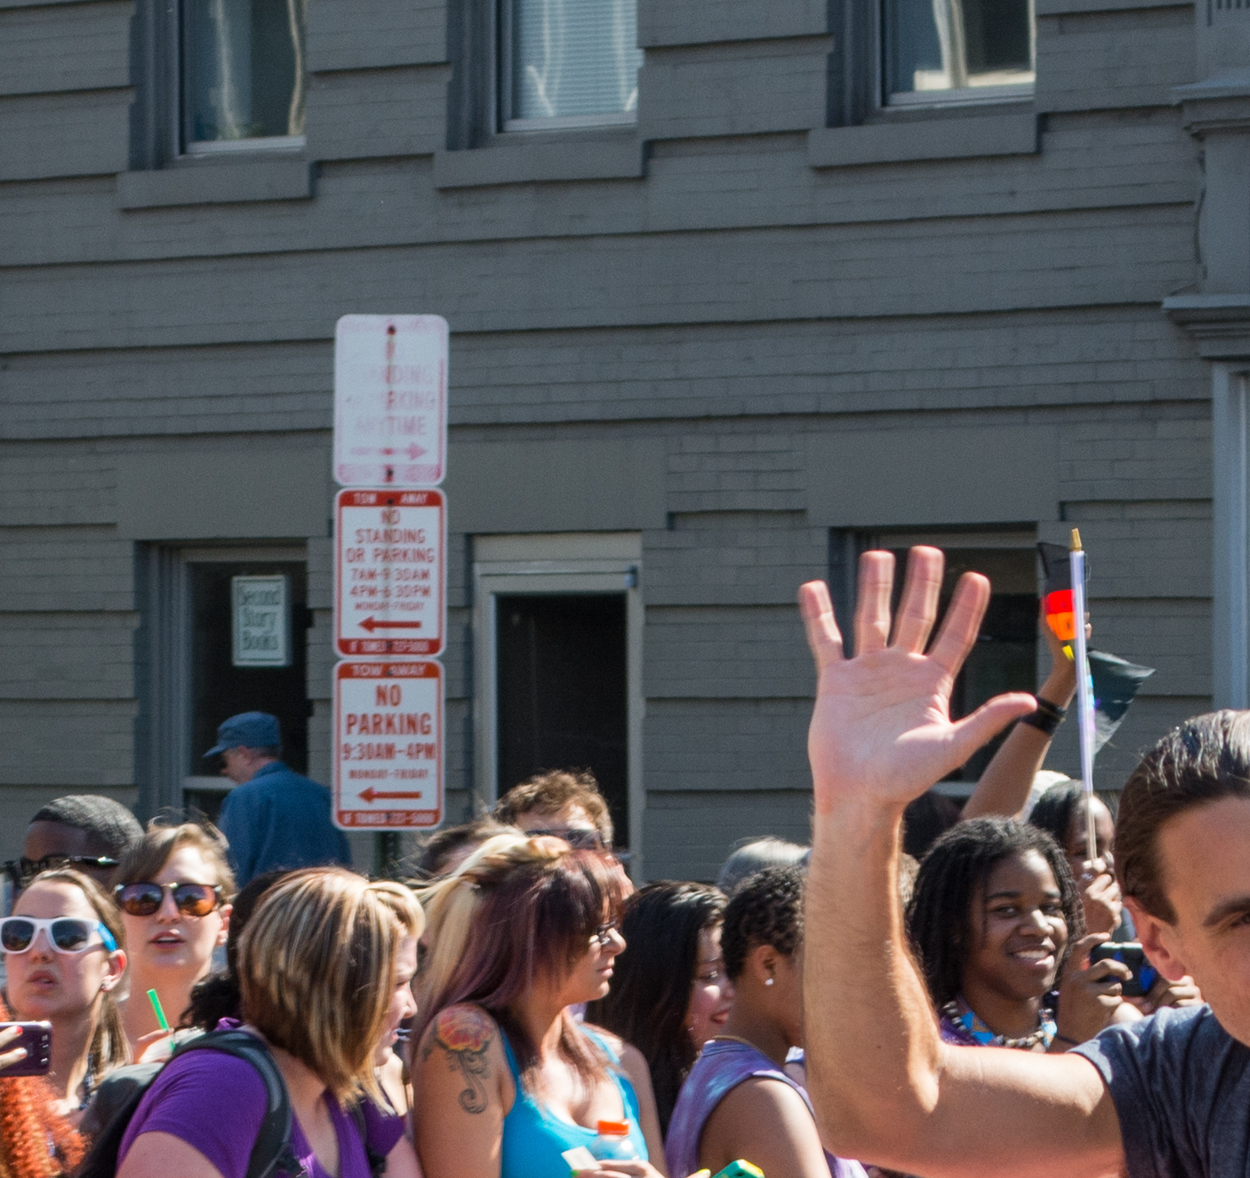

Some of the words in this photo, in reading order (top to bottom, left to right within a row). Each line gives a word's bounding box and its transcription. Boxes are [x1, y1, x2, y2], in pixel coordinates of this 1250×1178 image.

[353, 493, 377, 504] TOW
[400, 493, 428, 504] AWAY
[381, 509, 400, 524] NO
[354, 528, 426, 544] STANDING
[346, 547, 365, 563] OR
[372, 547, 435, 563] PARKING
[351, 567, 430, 581] 7AM-930AM
[350, 585, 431, 598] 4PM-630PM
[352, 665, 383, 676] TOW
[391, 665, 427, 676] AWAY
[375, 684, 402, 707] NO
[345, 713, 432, 735] PARKING
[342, 742, 436, 760] 9:30AM-4PM
[349, 769, 429, 779] MONDAY-FRIDAY
